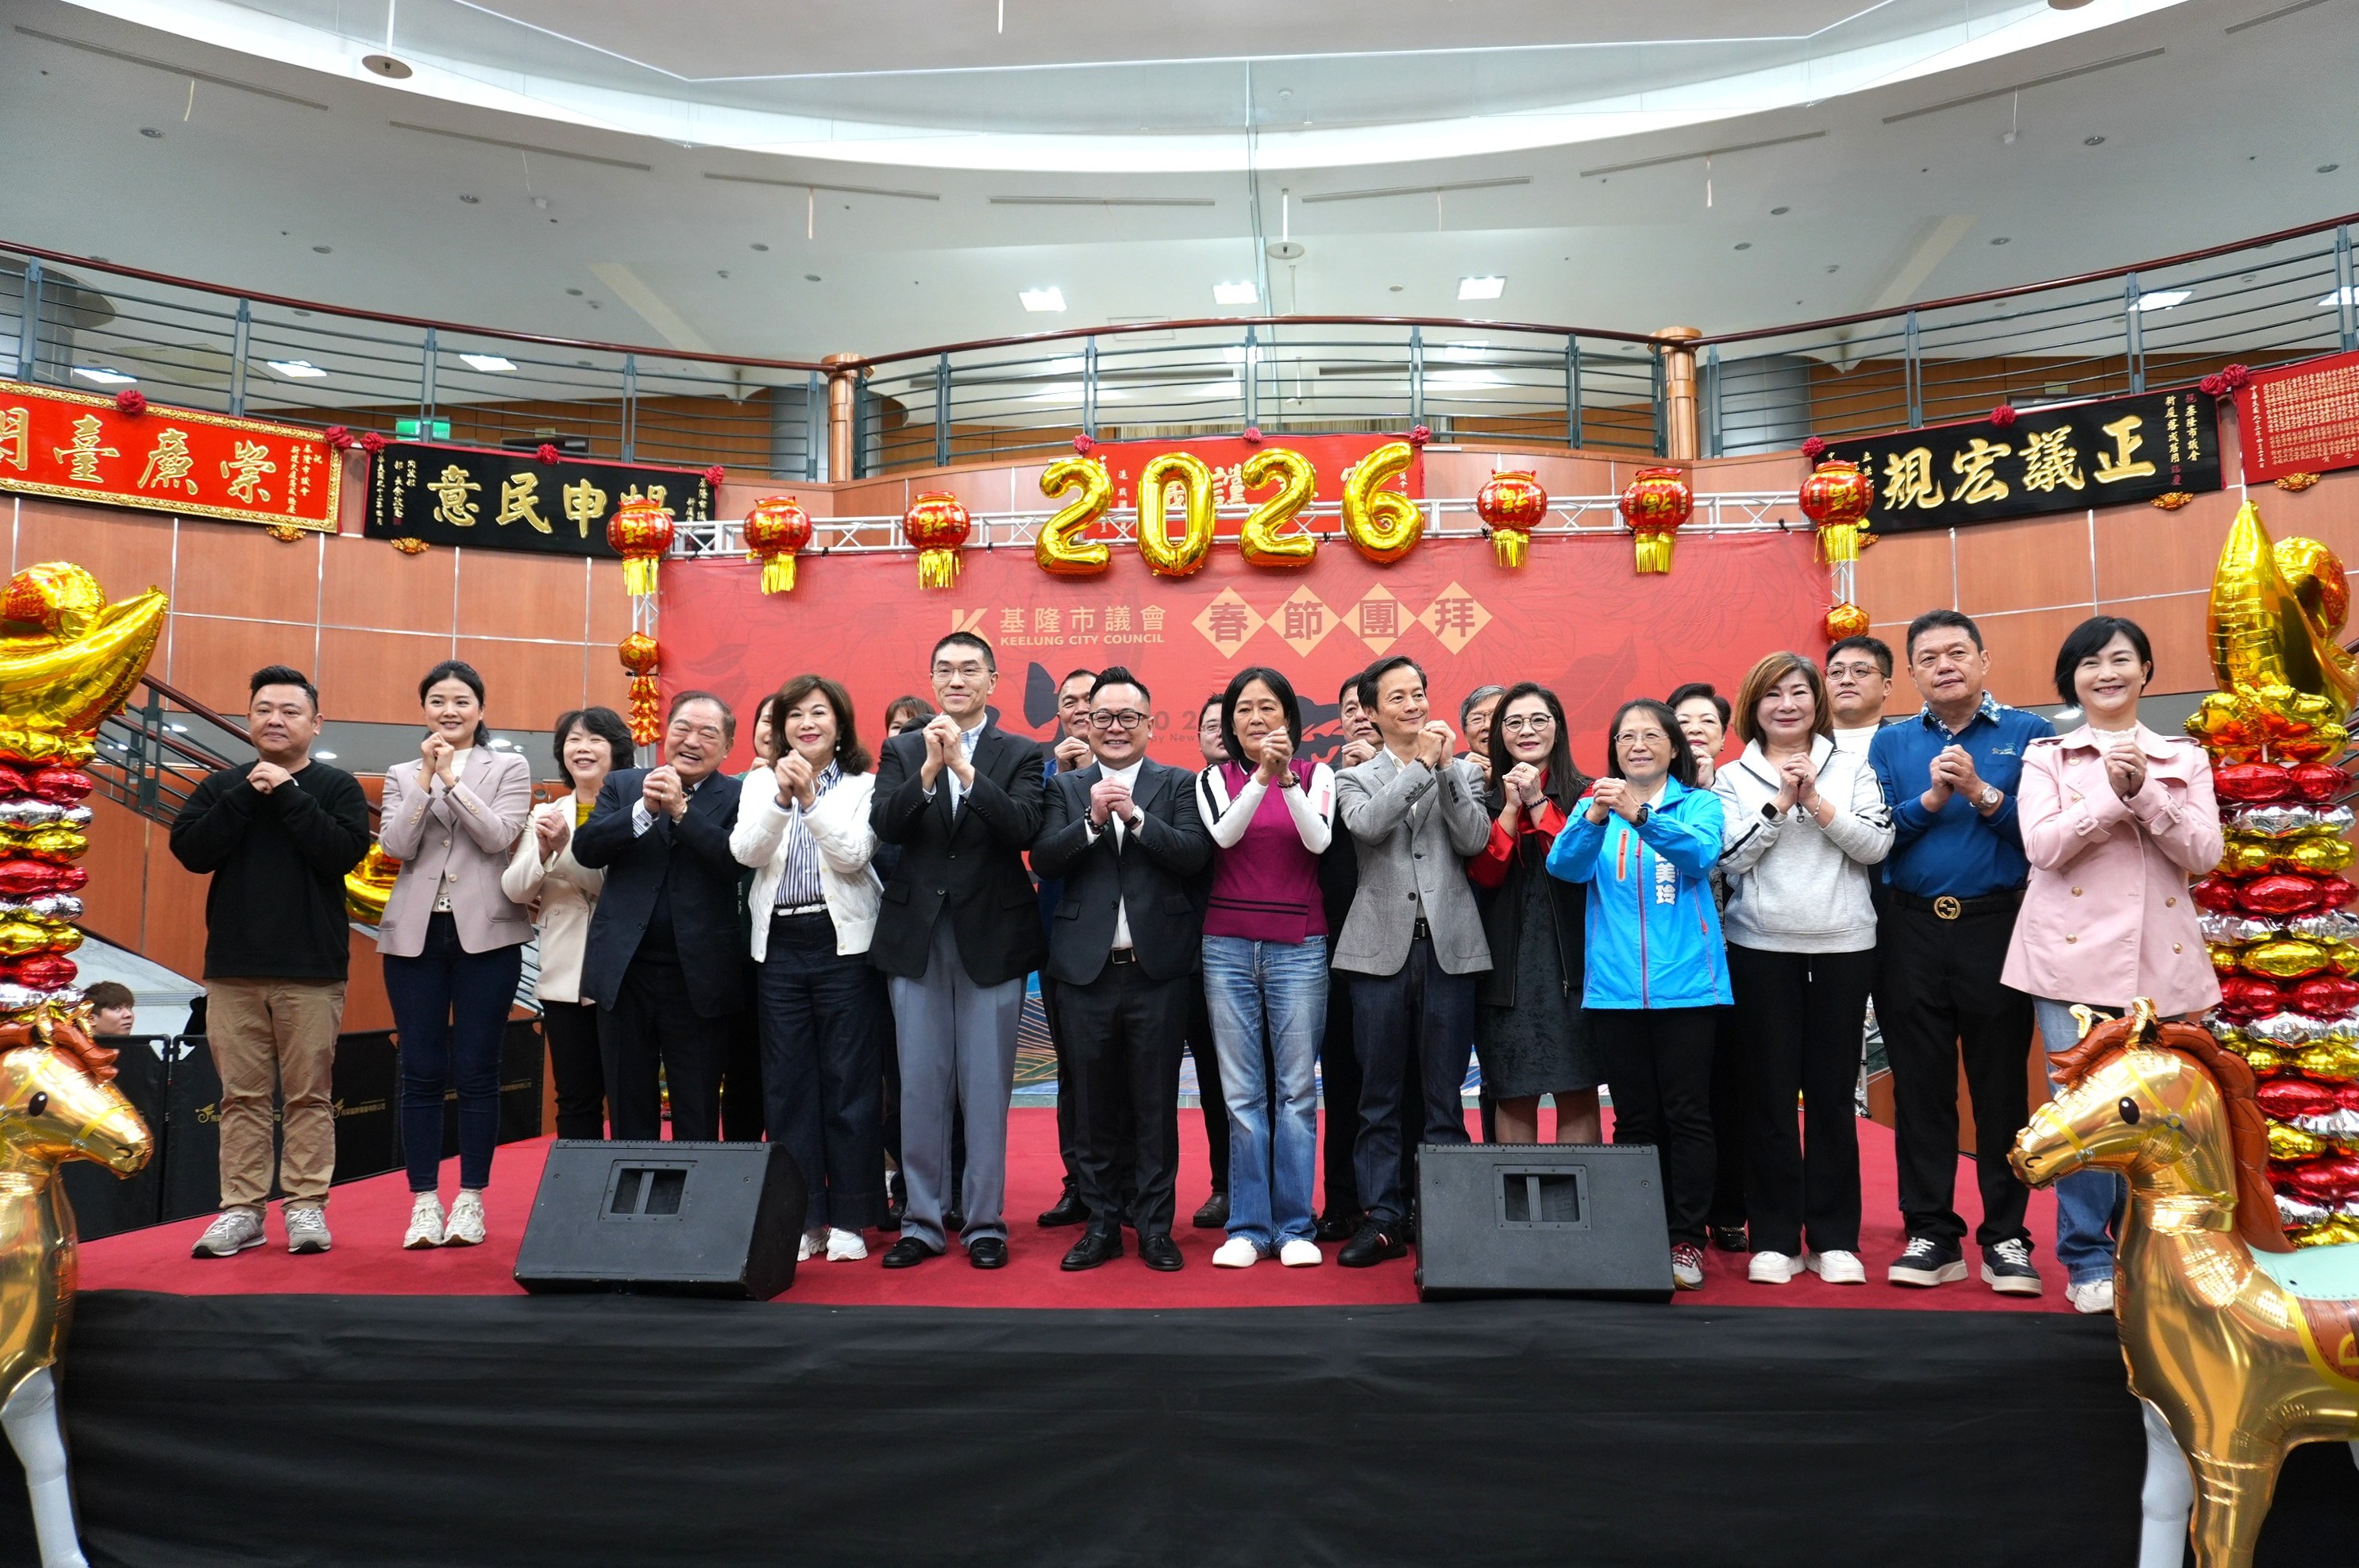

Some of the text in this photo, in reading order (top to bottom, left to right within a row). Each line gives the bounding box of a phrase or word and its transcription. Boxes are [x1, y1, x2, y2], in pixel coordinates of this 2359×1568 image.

[300, 444, 313, 497] 基隆市議會
[1035, 441, 1424, 576] 2026
[1000, 604, 1166, 634] 基隆市議會
[1000, 634, 1165, 646] KEELUNG CITY COUNCIL
[1208, 598, 1475, 642] 春節團拜
